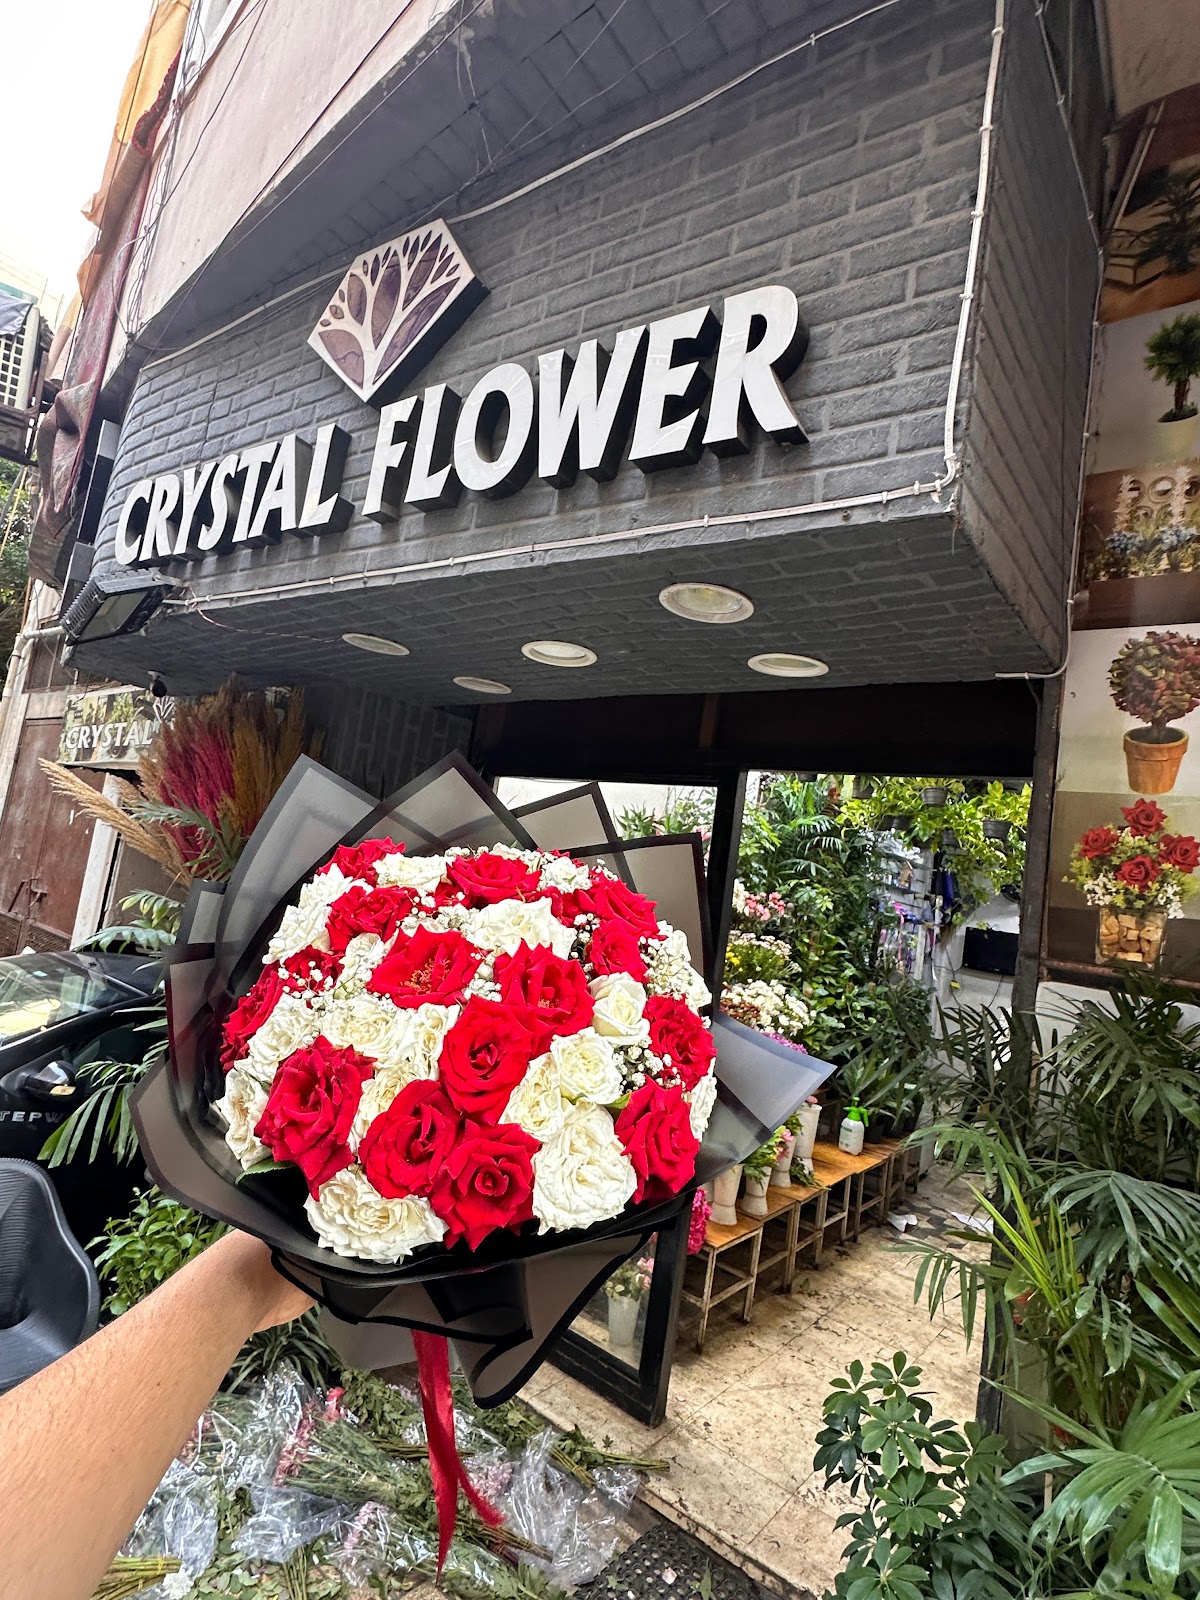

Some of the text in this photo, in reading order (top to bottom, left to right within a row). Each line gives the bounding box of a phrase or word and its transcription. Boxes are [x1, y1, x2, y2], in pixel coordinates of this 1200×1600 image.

[115, 285, 799, 565] CRYSTAL FLOWER
[65, 719, 153, 749] CRYSTAL
